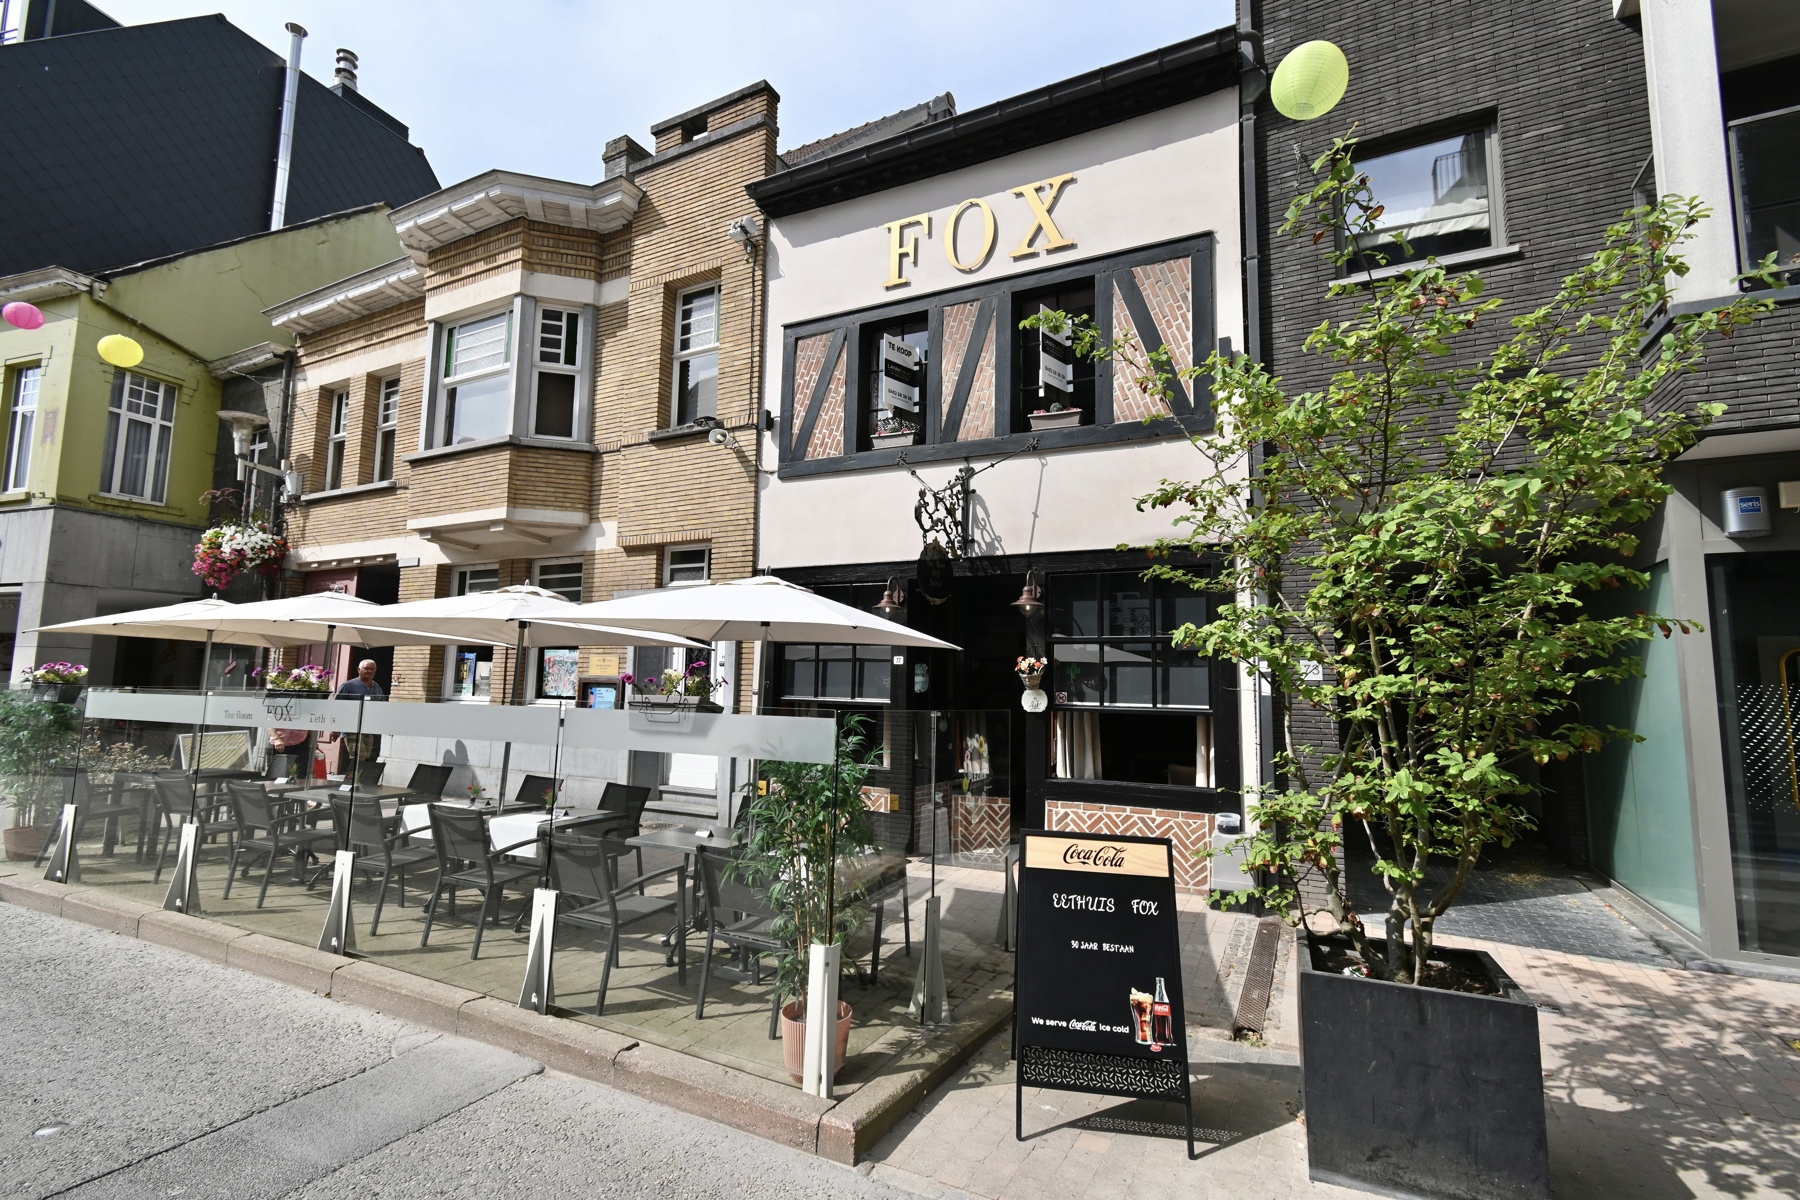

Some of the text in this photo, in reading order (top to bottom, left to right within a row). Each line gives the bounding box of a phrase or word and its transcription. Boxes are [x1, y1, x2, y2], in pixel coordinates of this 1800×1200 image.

[883, 172, 1075, 288] FOX
[888, 341, 912, 357] TE KOOP
[1740, 500, 1760, 508] seris
[1304, 664, 1320, 675] 73
[266, 705, 293, 722] FOX
[1063, 843, 1128, 868] Coca-Cola
[1052, 892, 1159, 916] EETHUIS FOX
[1080, 941, 1099, 951] JAAR
[1102, 942, 1135, 953] BESTAAN
[1031, 1016, 1044, 1025] We
[1045, 1020, 1067, 1028] serve
[1068, 1019, 1097, 1032] Coca-Cola
[1112, 1025, 1130, 1033] cold
